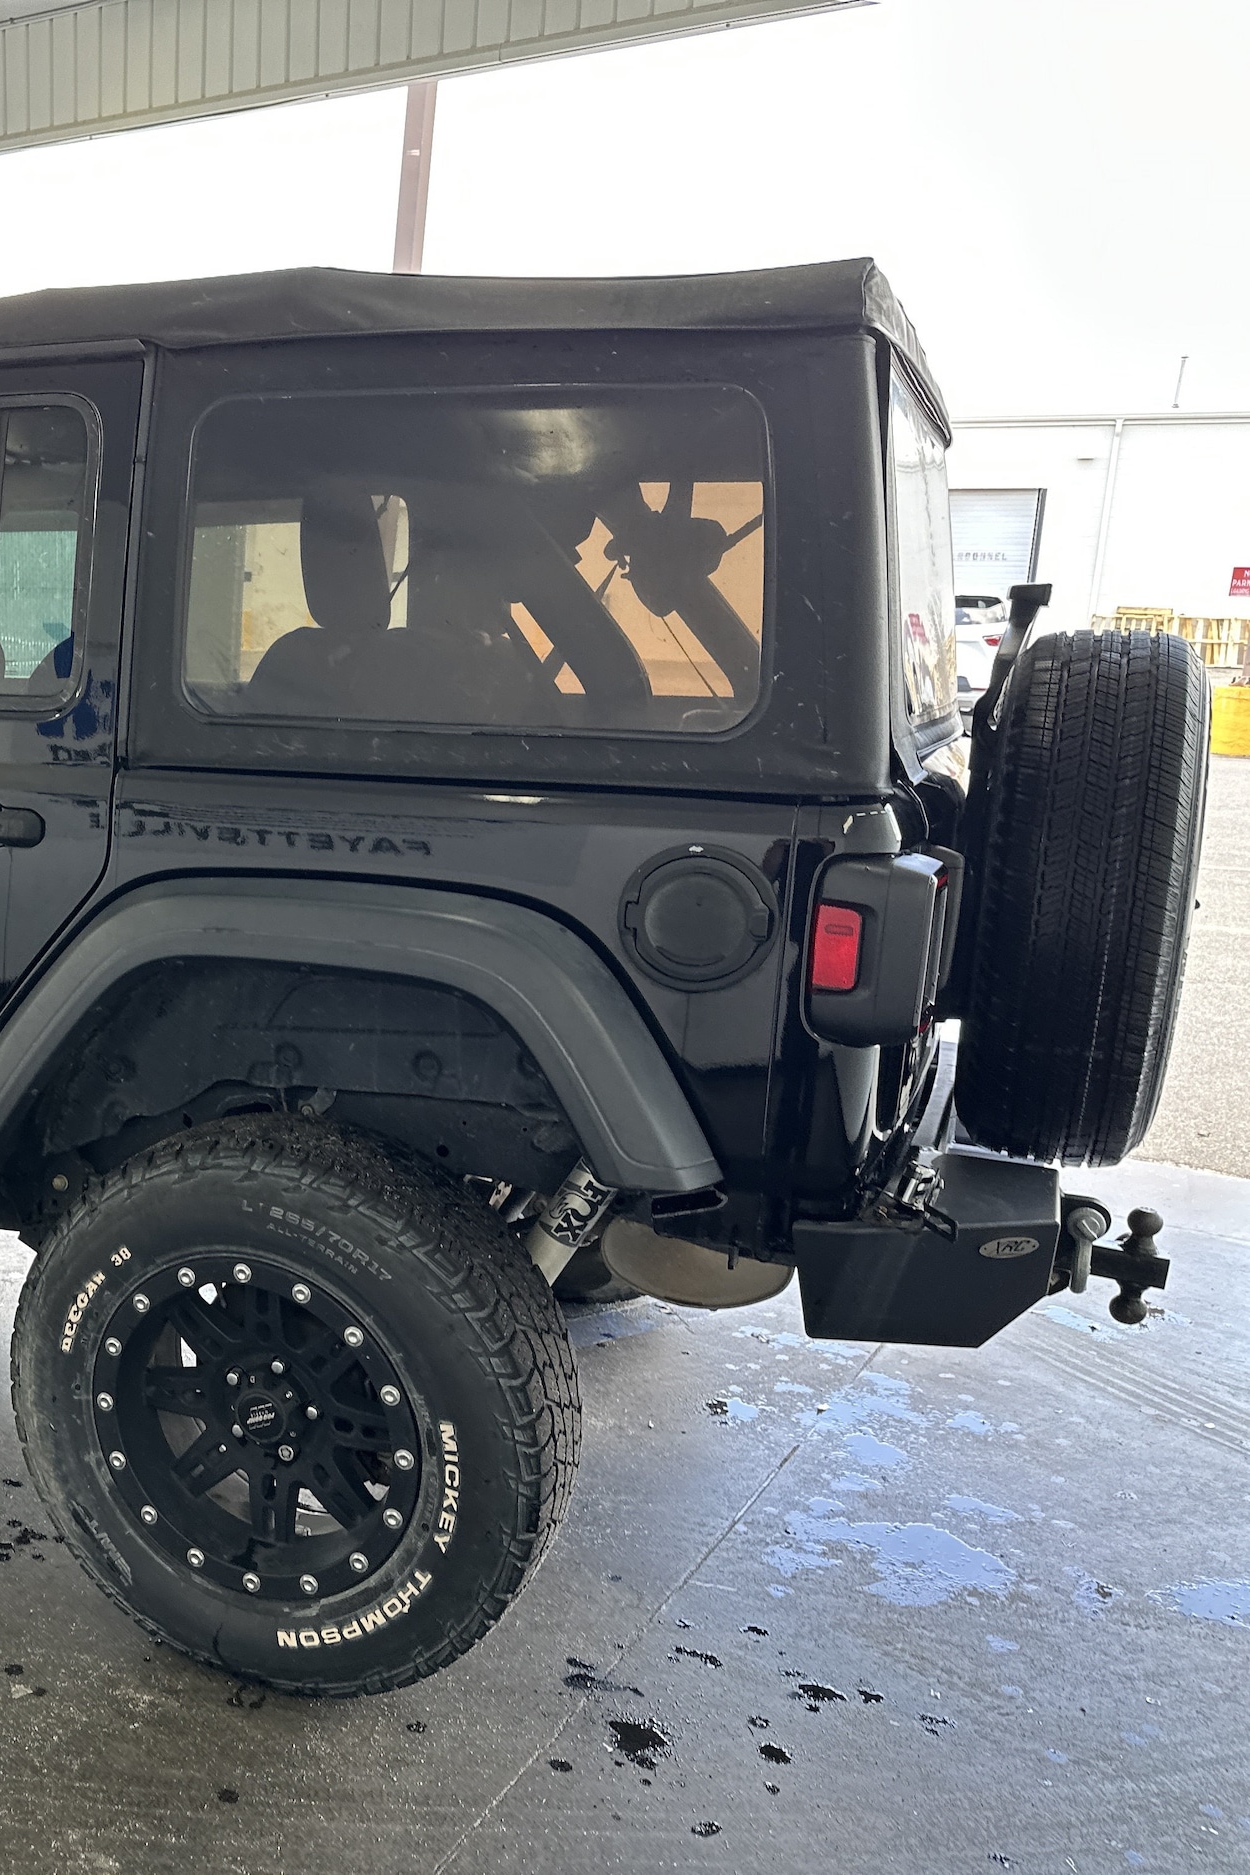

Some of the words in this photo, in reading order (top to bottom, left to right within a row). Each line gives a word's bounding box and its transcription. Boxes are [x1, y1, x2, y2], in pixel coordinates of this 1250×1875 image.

[266, 1222, 359, 1275] ALL-TERRAIN
[551, 1179, 611, 1243] FOX
[61, 1271, 106, 1353] DEEGAN
[111, 1246, 132, 1267] 38
[433, 1420, 461, 1553] MICKEY
[276, 1569, 432, 1649] THOMPSON
